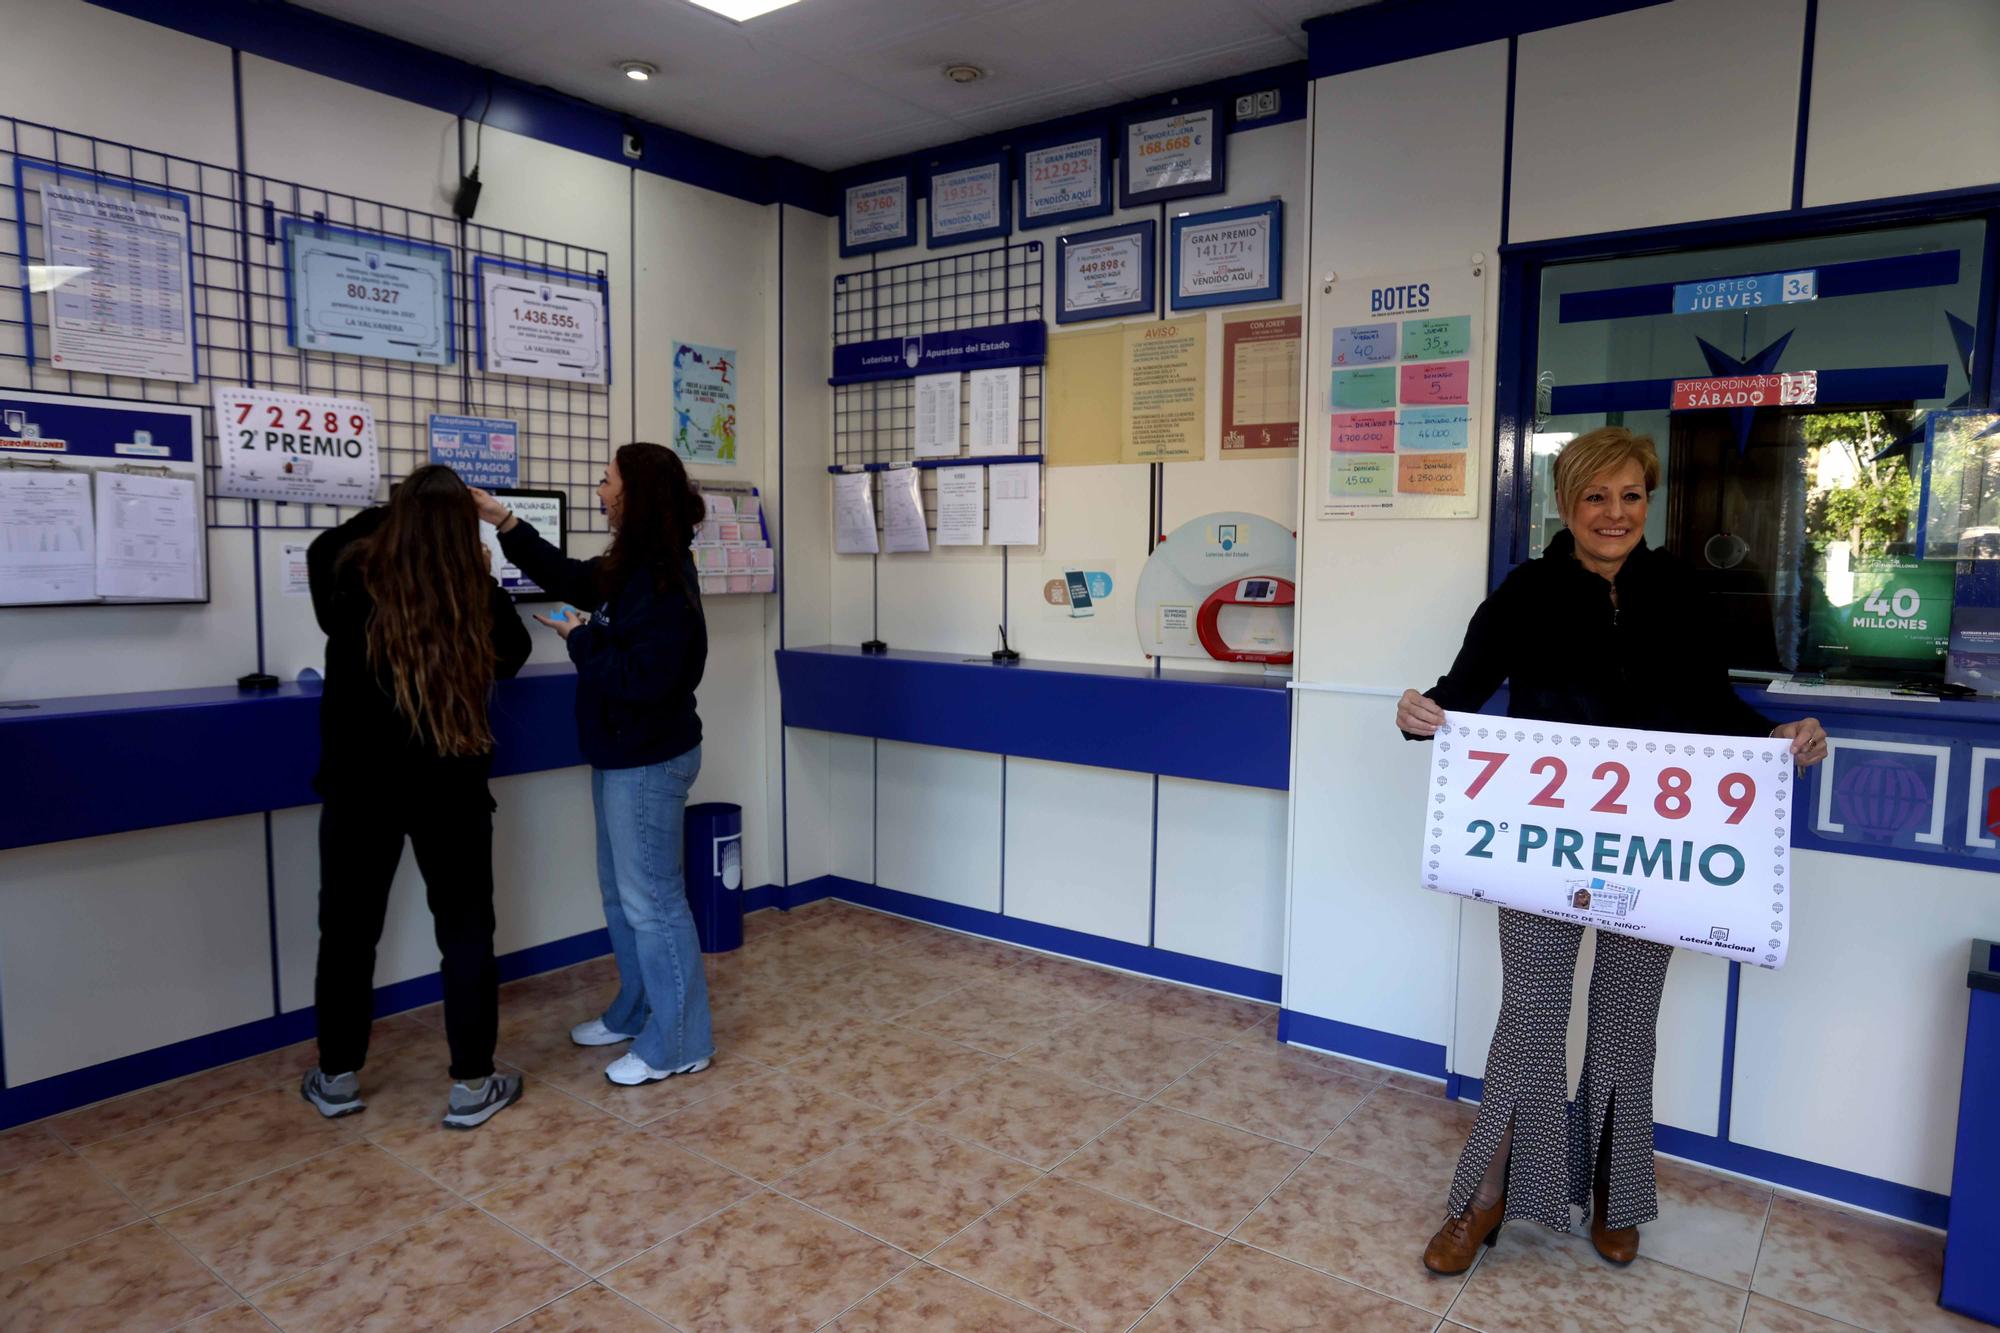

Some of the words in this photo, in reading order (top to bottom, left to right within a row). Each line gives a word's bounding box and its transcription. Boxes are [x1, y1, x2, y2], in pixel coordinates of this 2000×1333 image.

[1139, 136, 1190, 156] 168.668
[1194, 135, 1202, 145] €
[1044, 154, 1064, 163] GRAN
[1065, 148, 1092, 159] PREMIO
[1034, 194, 1070, 206] VENDIDO
[1072, 188, 1092, 200] AQUÍ
[940, 215, 971, 227] VENDIDO
[1192, 233, 1218, 244] GRAN
[1221, 228, 1257, 240] PREMIO
[1196, 240, 1244, 258] 141.171
[1192, 275, 1229, 286] VENDIDO
[1232, 269, 1253, 280] AQUÍ
[347, 283, 400, 304] 80.327
[1696, 279, 1758, 296] SORTEO
[1371, 283, 1430, 312] BOTES
[1690, 291, 1763, 311] JUEVES
[345, 318, 357, 327] LA
[513, 307, 574, 328] 1.436.555
[861, 355, 893, 365] Loterías
[926, 345, 963, 358] Apuestas
[965, 344, 978, 354] del
[980, 340, 1010, 352] Estado
[1354, 345, 1373, 357] 40
[1429, 382, 1441, 394] 5
[1676, 376, 1780, 393] EXTRAORDINARIO
[1688, 388, 1764, 407] SÁBADO
[433, 416, 480, 427] Aceptamos
[483, 420, 513, 430] Tarjetas
[265, 431, 362, 458] PREMIO
[437, 434, 455, 442] VISA
[437, 448, 453, 458] NO
[455, 449, 477, 459] HAY
[475, 462, 510, 473] PAGOS
[468, 474, 512, 485] TARJETA
[1863, 587, 1921, 618] 40
[1852, 617, 1928, 630] MILLONES
[1463, 749, 1757, 826] 72289
[1516, 823, 1746, 887] PREMIO
[1541, 908, 1579, 921] SORTEO
[1581, 915, 1593, 923] DE
[1679, 935, 1713, 946] Lotería
[1714, 941, 1755, 953] Nacional
